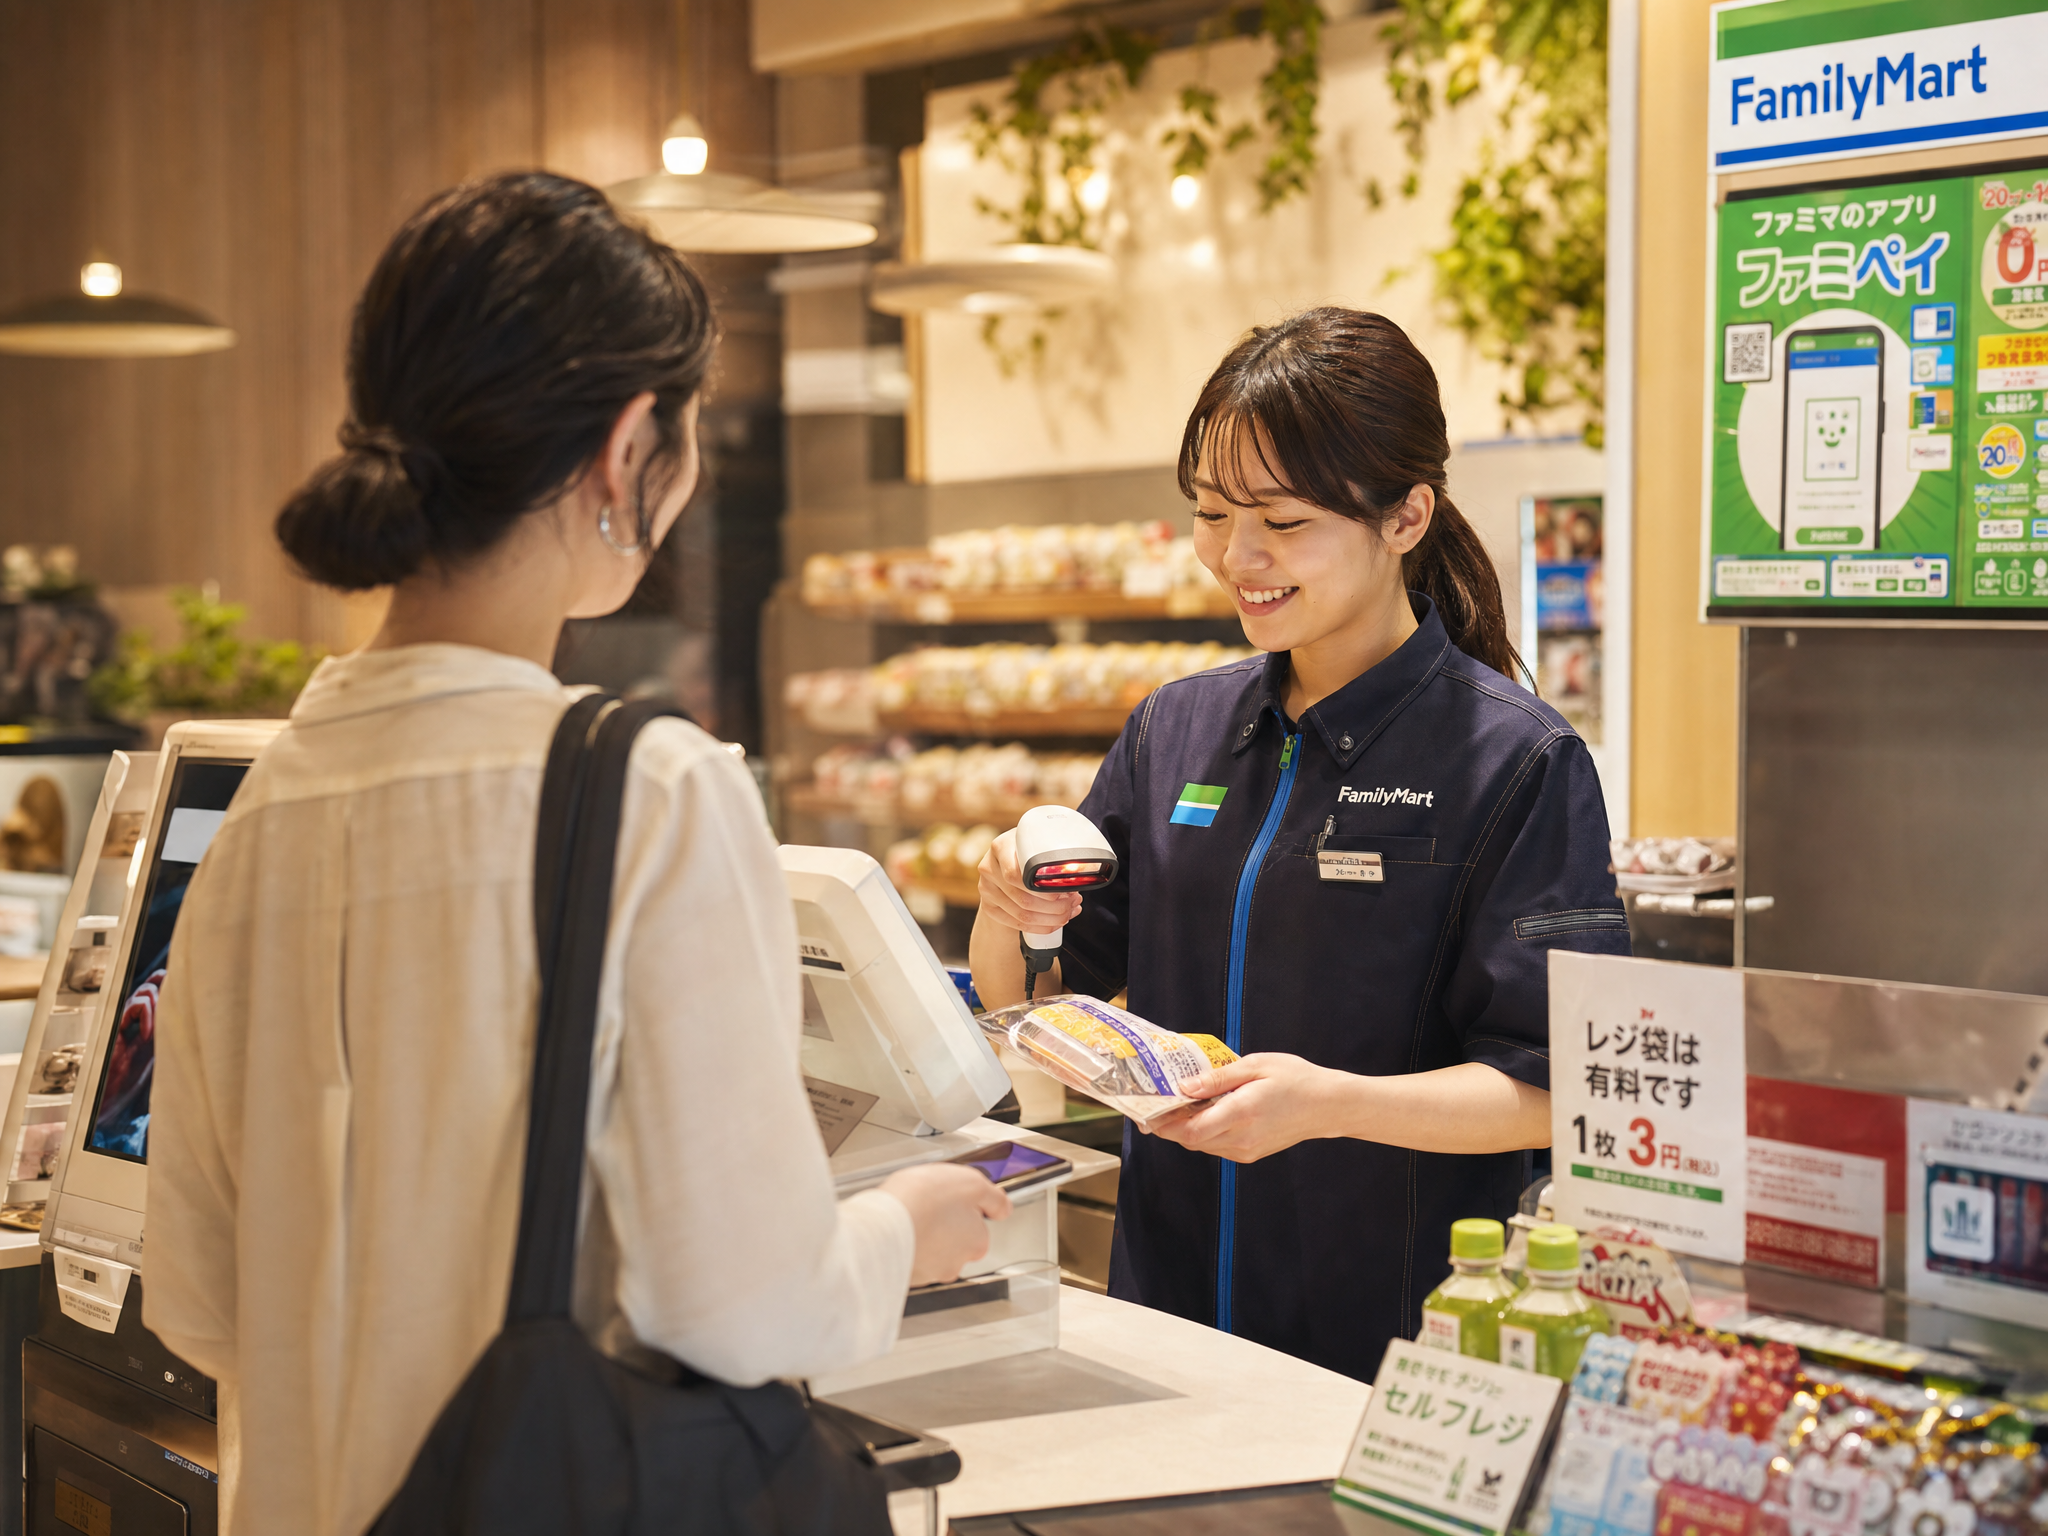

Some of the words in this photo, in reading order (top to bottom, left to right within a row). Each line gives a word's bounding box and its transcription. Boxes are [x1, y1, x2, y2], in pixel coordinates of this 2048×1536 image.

[1731, 44, 1987, 126] FamilyMart
[1752, 194, 1937, 238] ファミマのアプリ
[1736, 231, 1950, 308] ファミペイ
[1337, 785, 1435, 808] FamilyMart
[1587, 1021, 1700, 1066] レジ袋は
[1585, 1063, 1701, 1110] 有料です
[1572, 1114, 1617, 1160] 1枚
[1384, 1382, 1533, 1445] セルフレジ
